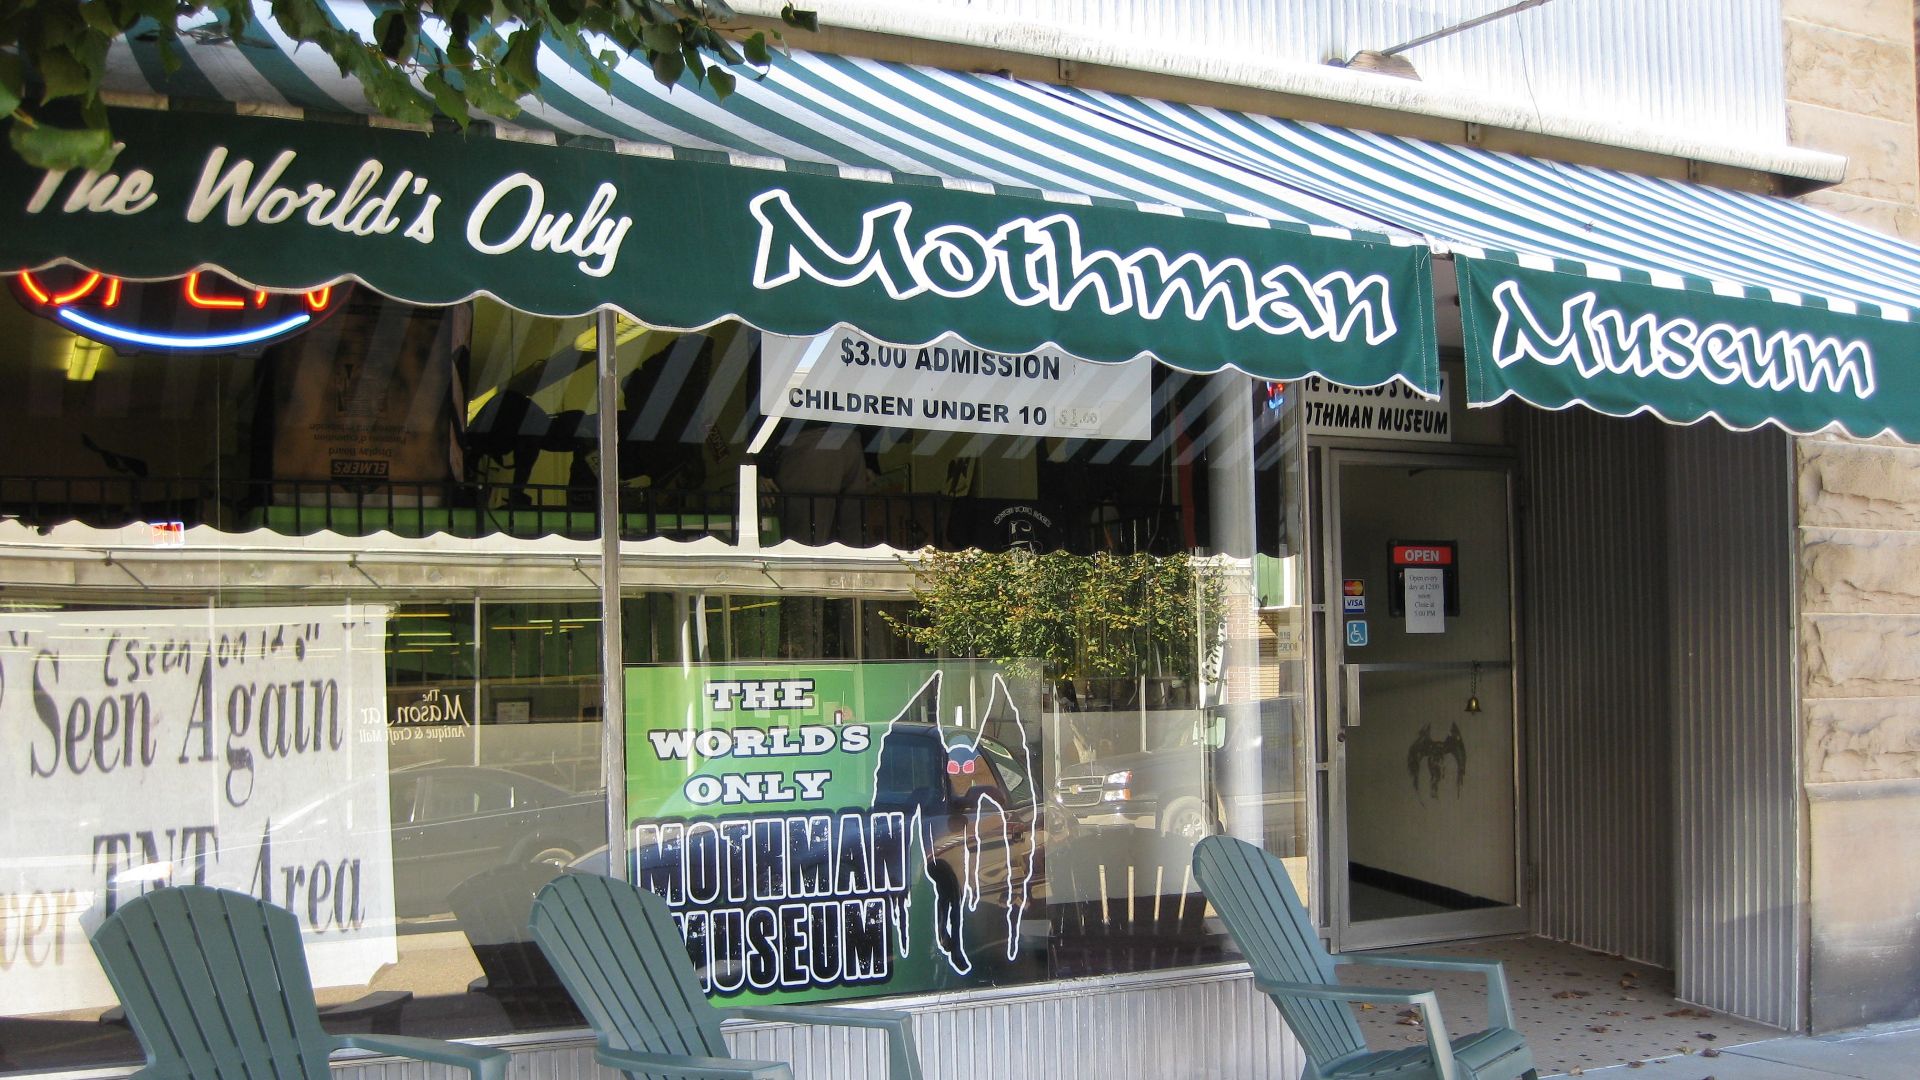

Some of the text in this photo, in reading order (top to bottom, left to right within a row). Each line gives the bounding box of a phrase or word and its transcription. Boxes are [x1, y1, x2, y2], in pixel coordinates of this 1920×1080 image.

[186, 146, 441, 244] World's
[466, 172, 633, 277] Only
[749, 189, 1397, 346] Mothman
[840, 336, 1060, 380] $3.00 ADMISSION
[1492, 280, 1875, 398] Museum
[788, 387, 1048, 426] CHILDREN UNDER 10
[1378, 407, 1448, 435] MUSEUM
[1404, 549, 1440, 562] OPEN
[1346, 599, 1364, 607] VISA
[705, 679, 816, 712] THE
[31, 640, 344, 807] Seen Again
[648, 711, 871, 762] WORLD'S
[684, 771, 832, 806] ONLY
[92, 817, 367, 935] TNT Area
[635, 812, 906, 909] MOTHMAN
